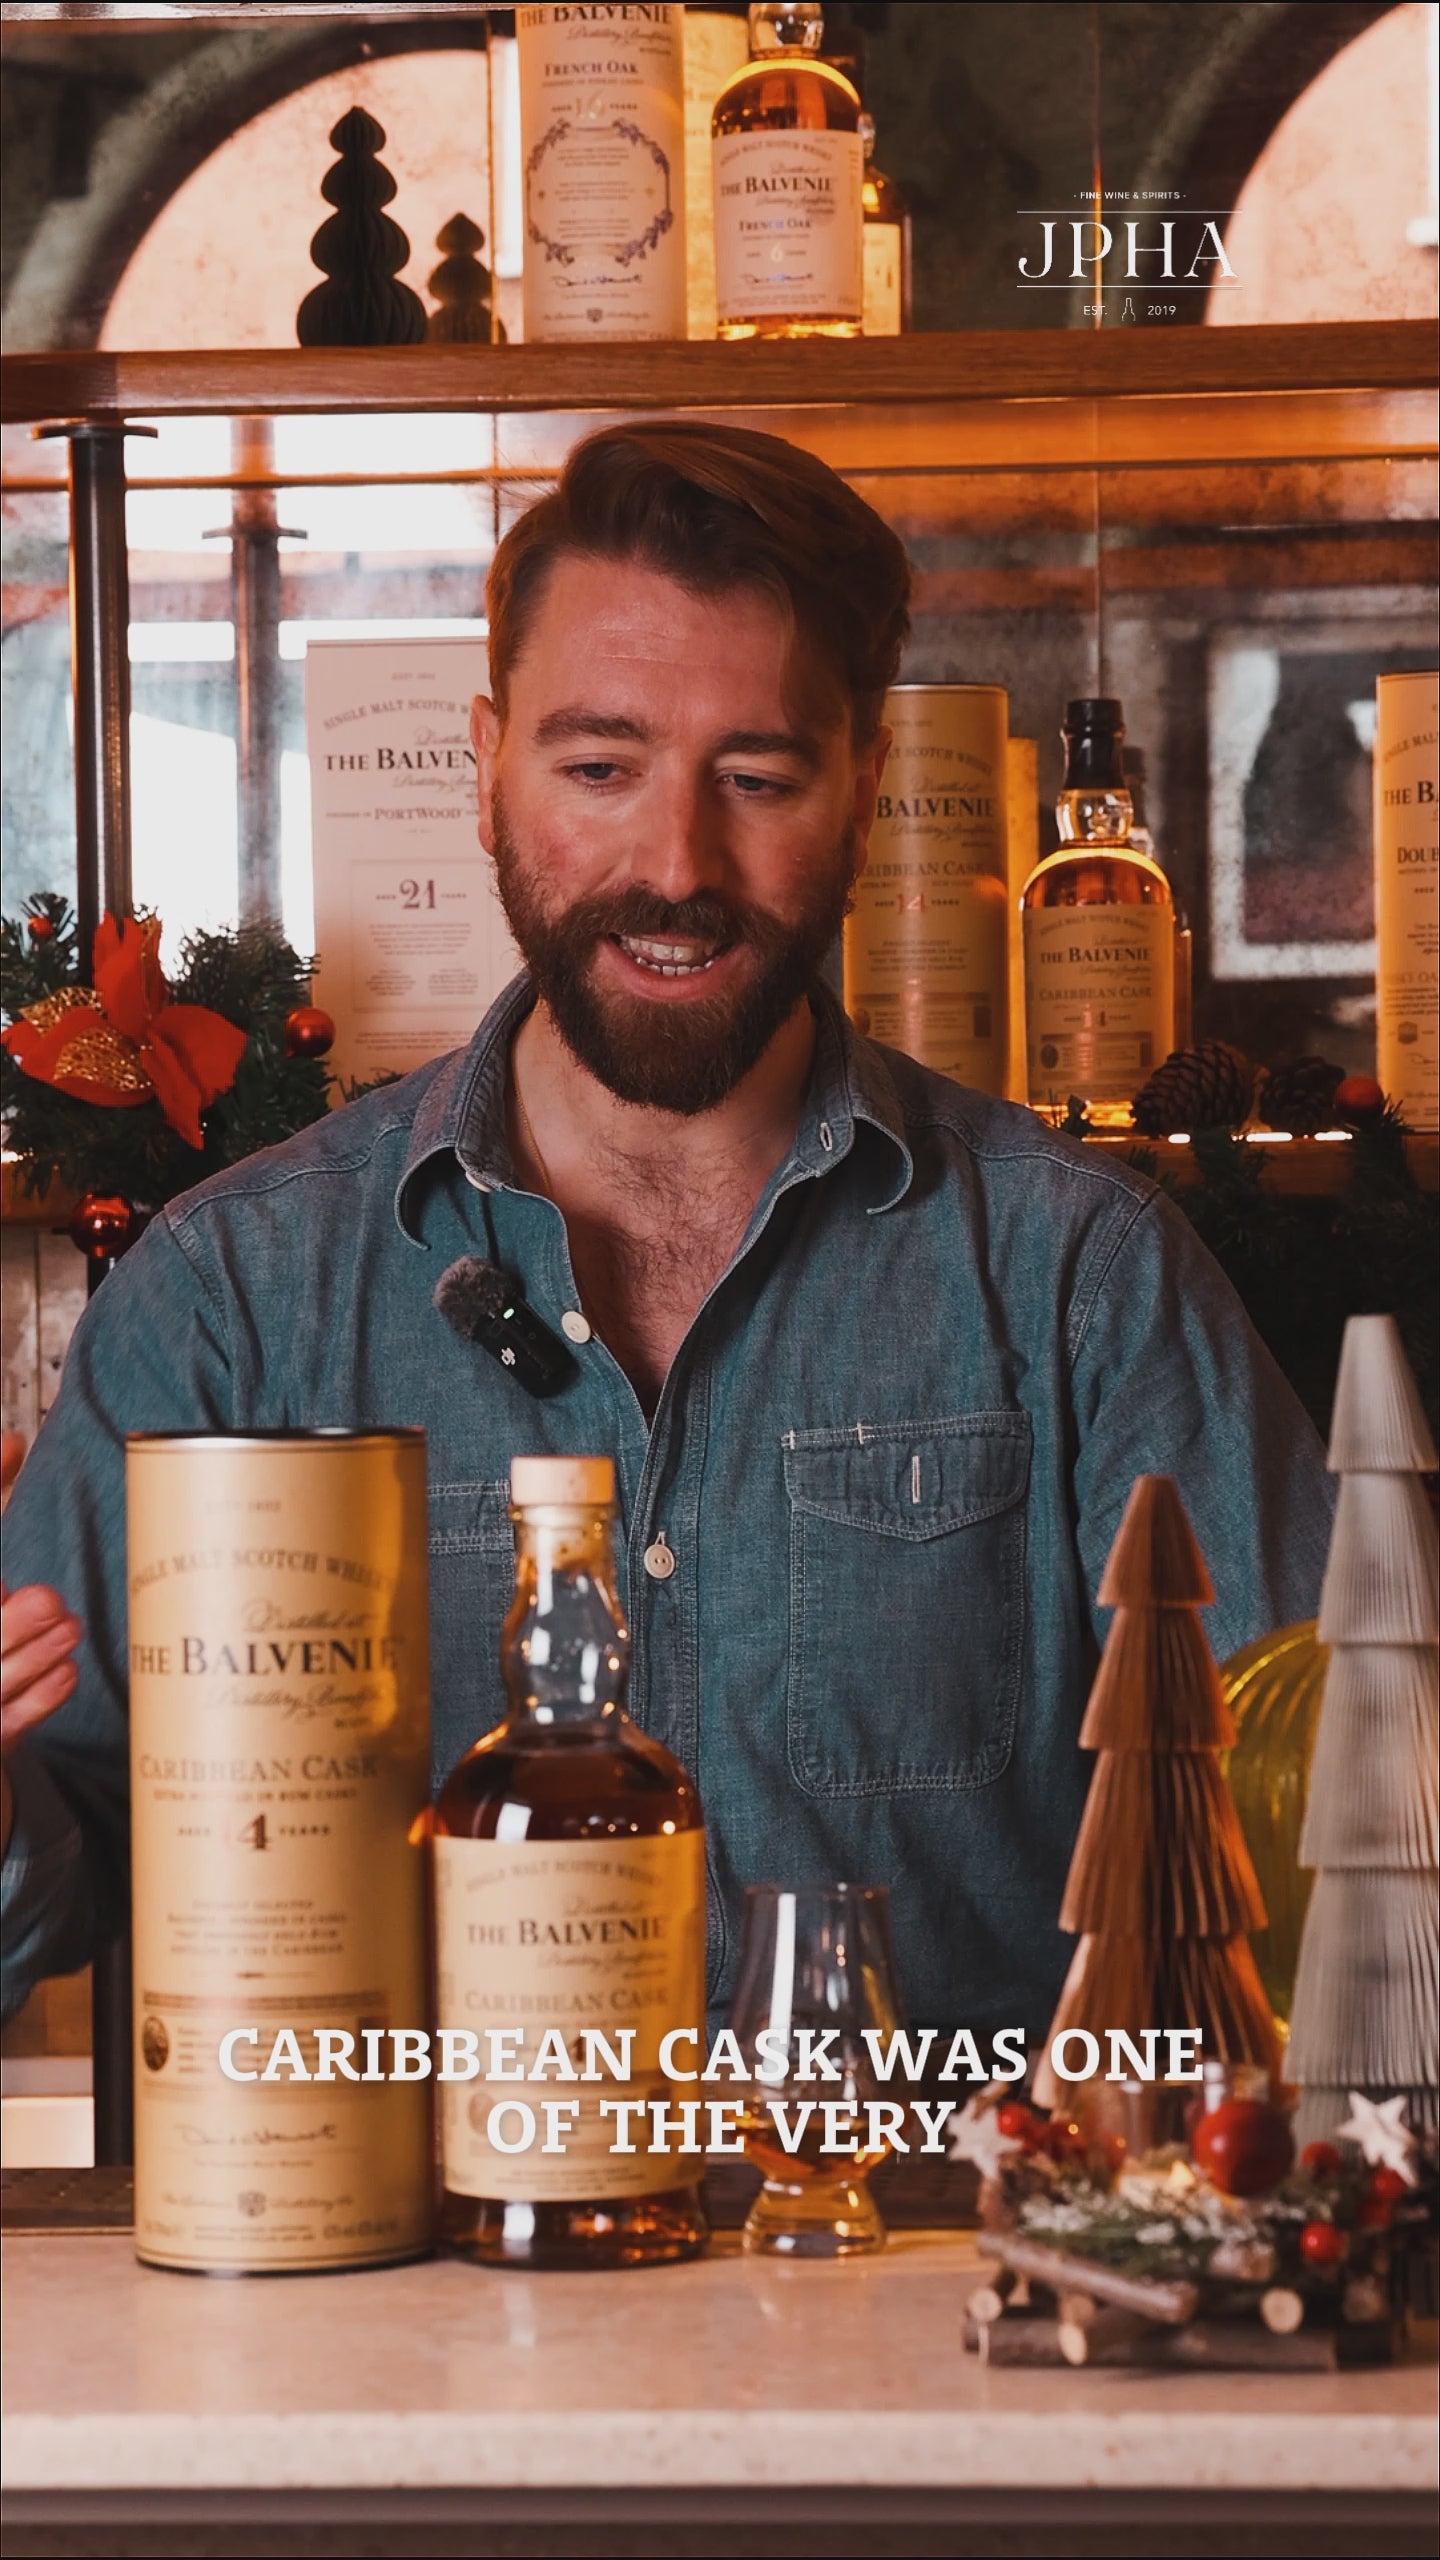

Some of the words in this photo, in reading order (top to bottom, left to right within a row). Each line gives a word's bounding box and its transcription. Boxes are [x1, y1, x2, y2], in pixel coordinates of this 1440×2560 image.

[544, 61, 602, 77] FRENCH
[606, 60, 639, 74] OAK
[745, 176, 832, 194] BALVENIE
[787, 217, 812, 229] OAK
[323, 705, 368, 731] SINGLE
[370, 699, 404, 714] MALT
[407, 699, 456, 714] SCOTCH
[324, 754, 370, 771] THE
[876, 795, 994, 819] BALVENIE
[1383, 787, 1412, 807] THE
[399, 879, 437, 910] 21
[1040, 952, 1064, 965] THE
[1068, 947, 1150, 964] BALVENIE
[1039, 986, 1117, 1001] CARIBBEAN
[231, 1548, 319, 1574] SCOTCH
[131, 1644, 172, 1675] THE
[181, 1634, 401, 1677] BALVENIE
[138, 1753, 292, 1782] CARIBBEAN
[300, 1754, 379, 1781] CASK
[466, 1922, 510, 1947] THE
[518, 1917, 666, 1946] BALVENIE
[463, 1989, 601, 2014] CARIBBEAN
[603, 1986, 669, 2010] CASK
